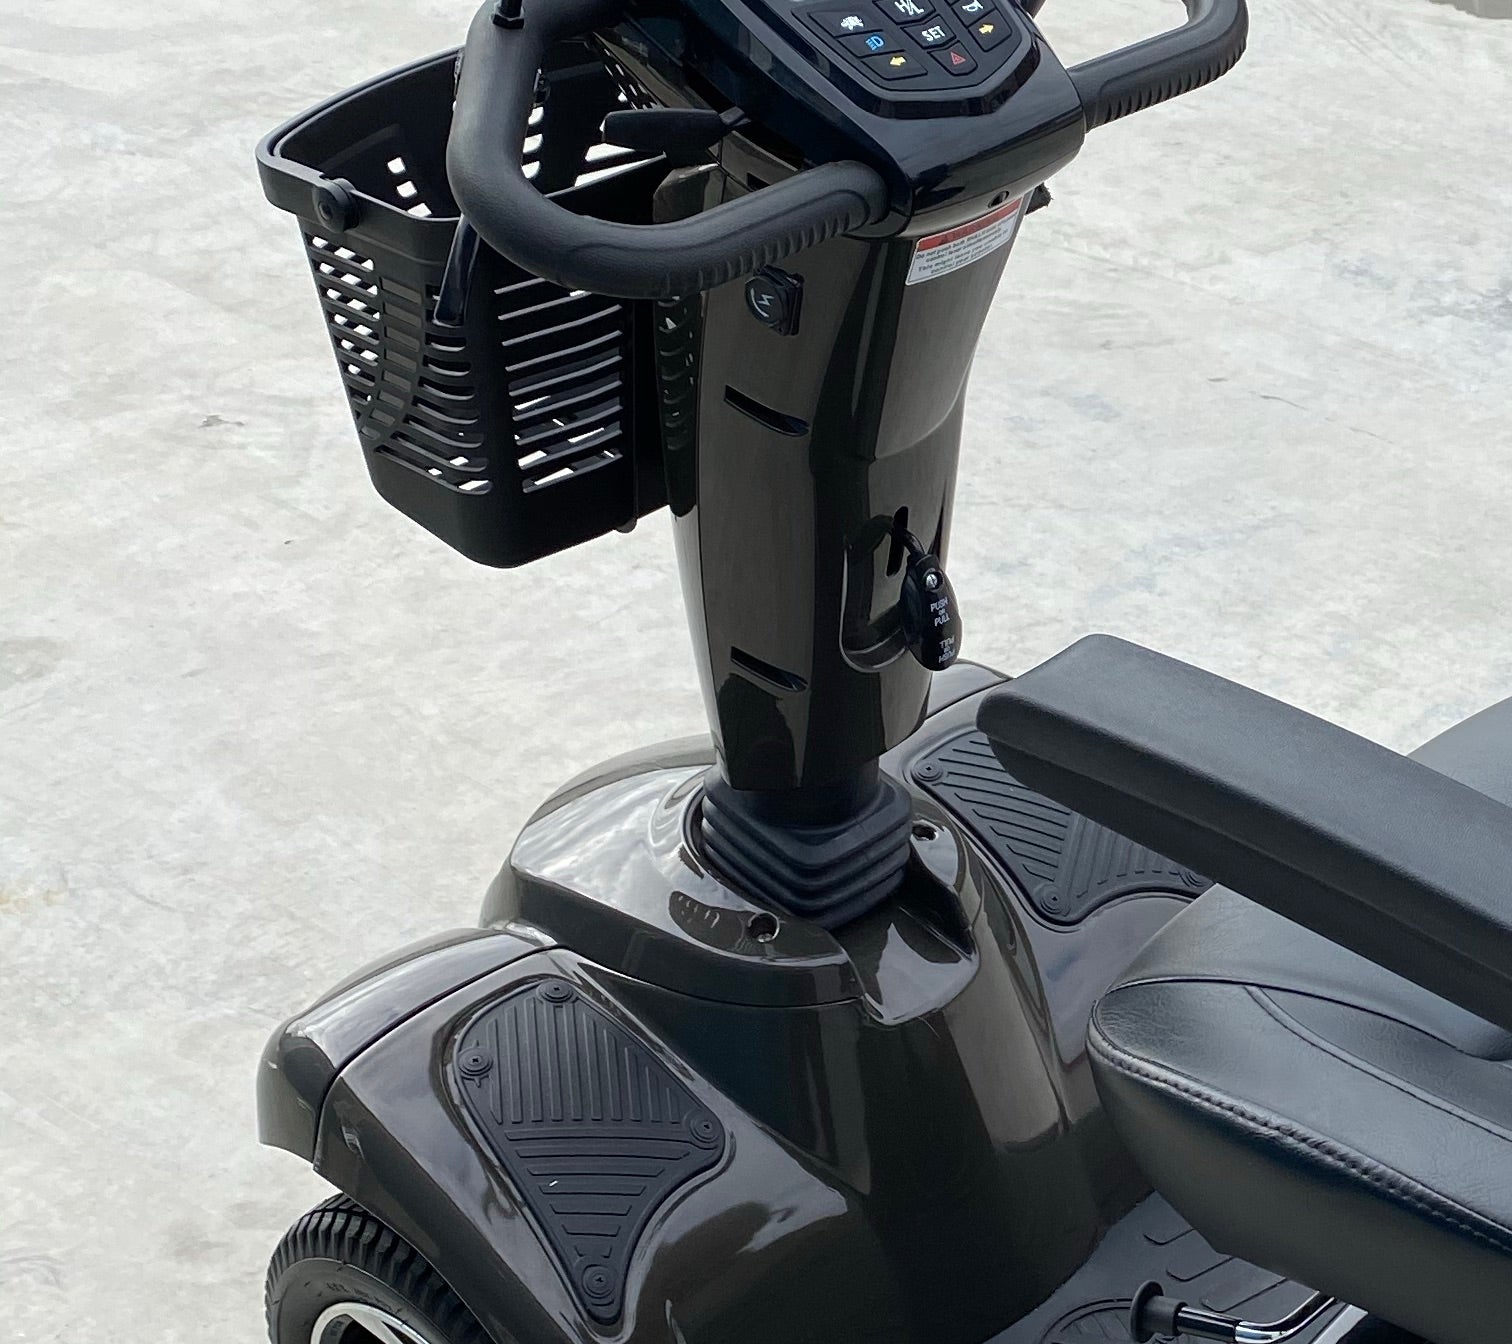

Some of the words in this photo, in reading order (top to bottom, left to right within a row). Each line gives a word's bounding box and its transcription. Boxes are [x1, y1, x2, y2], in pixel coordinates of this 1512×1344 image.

[921, 25, 946, 42] SET
[930, 596, 949, 613] PUSH
[934, 613, 951, 627] PULL
